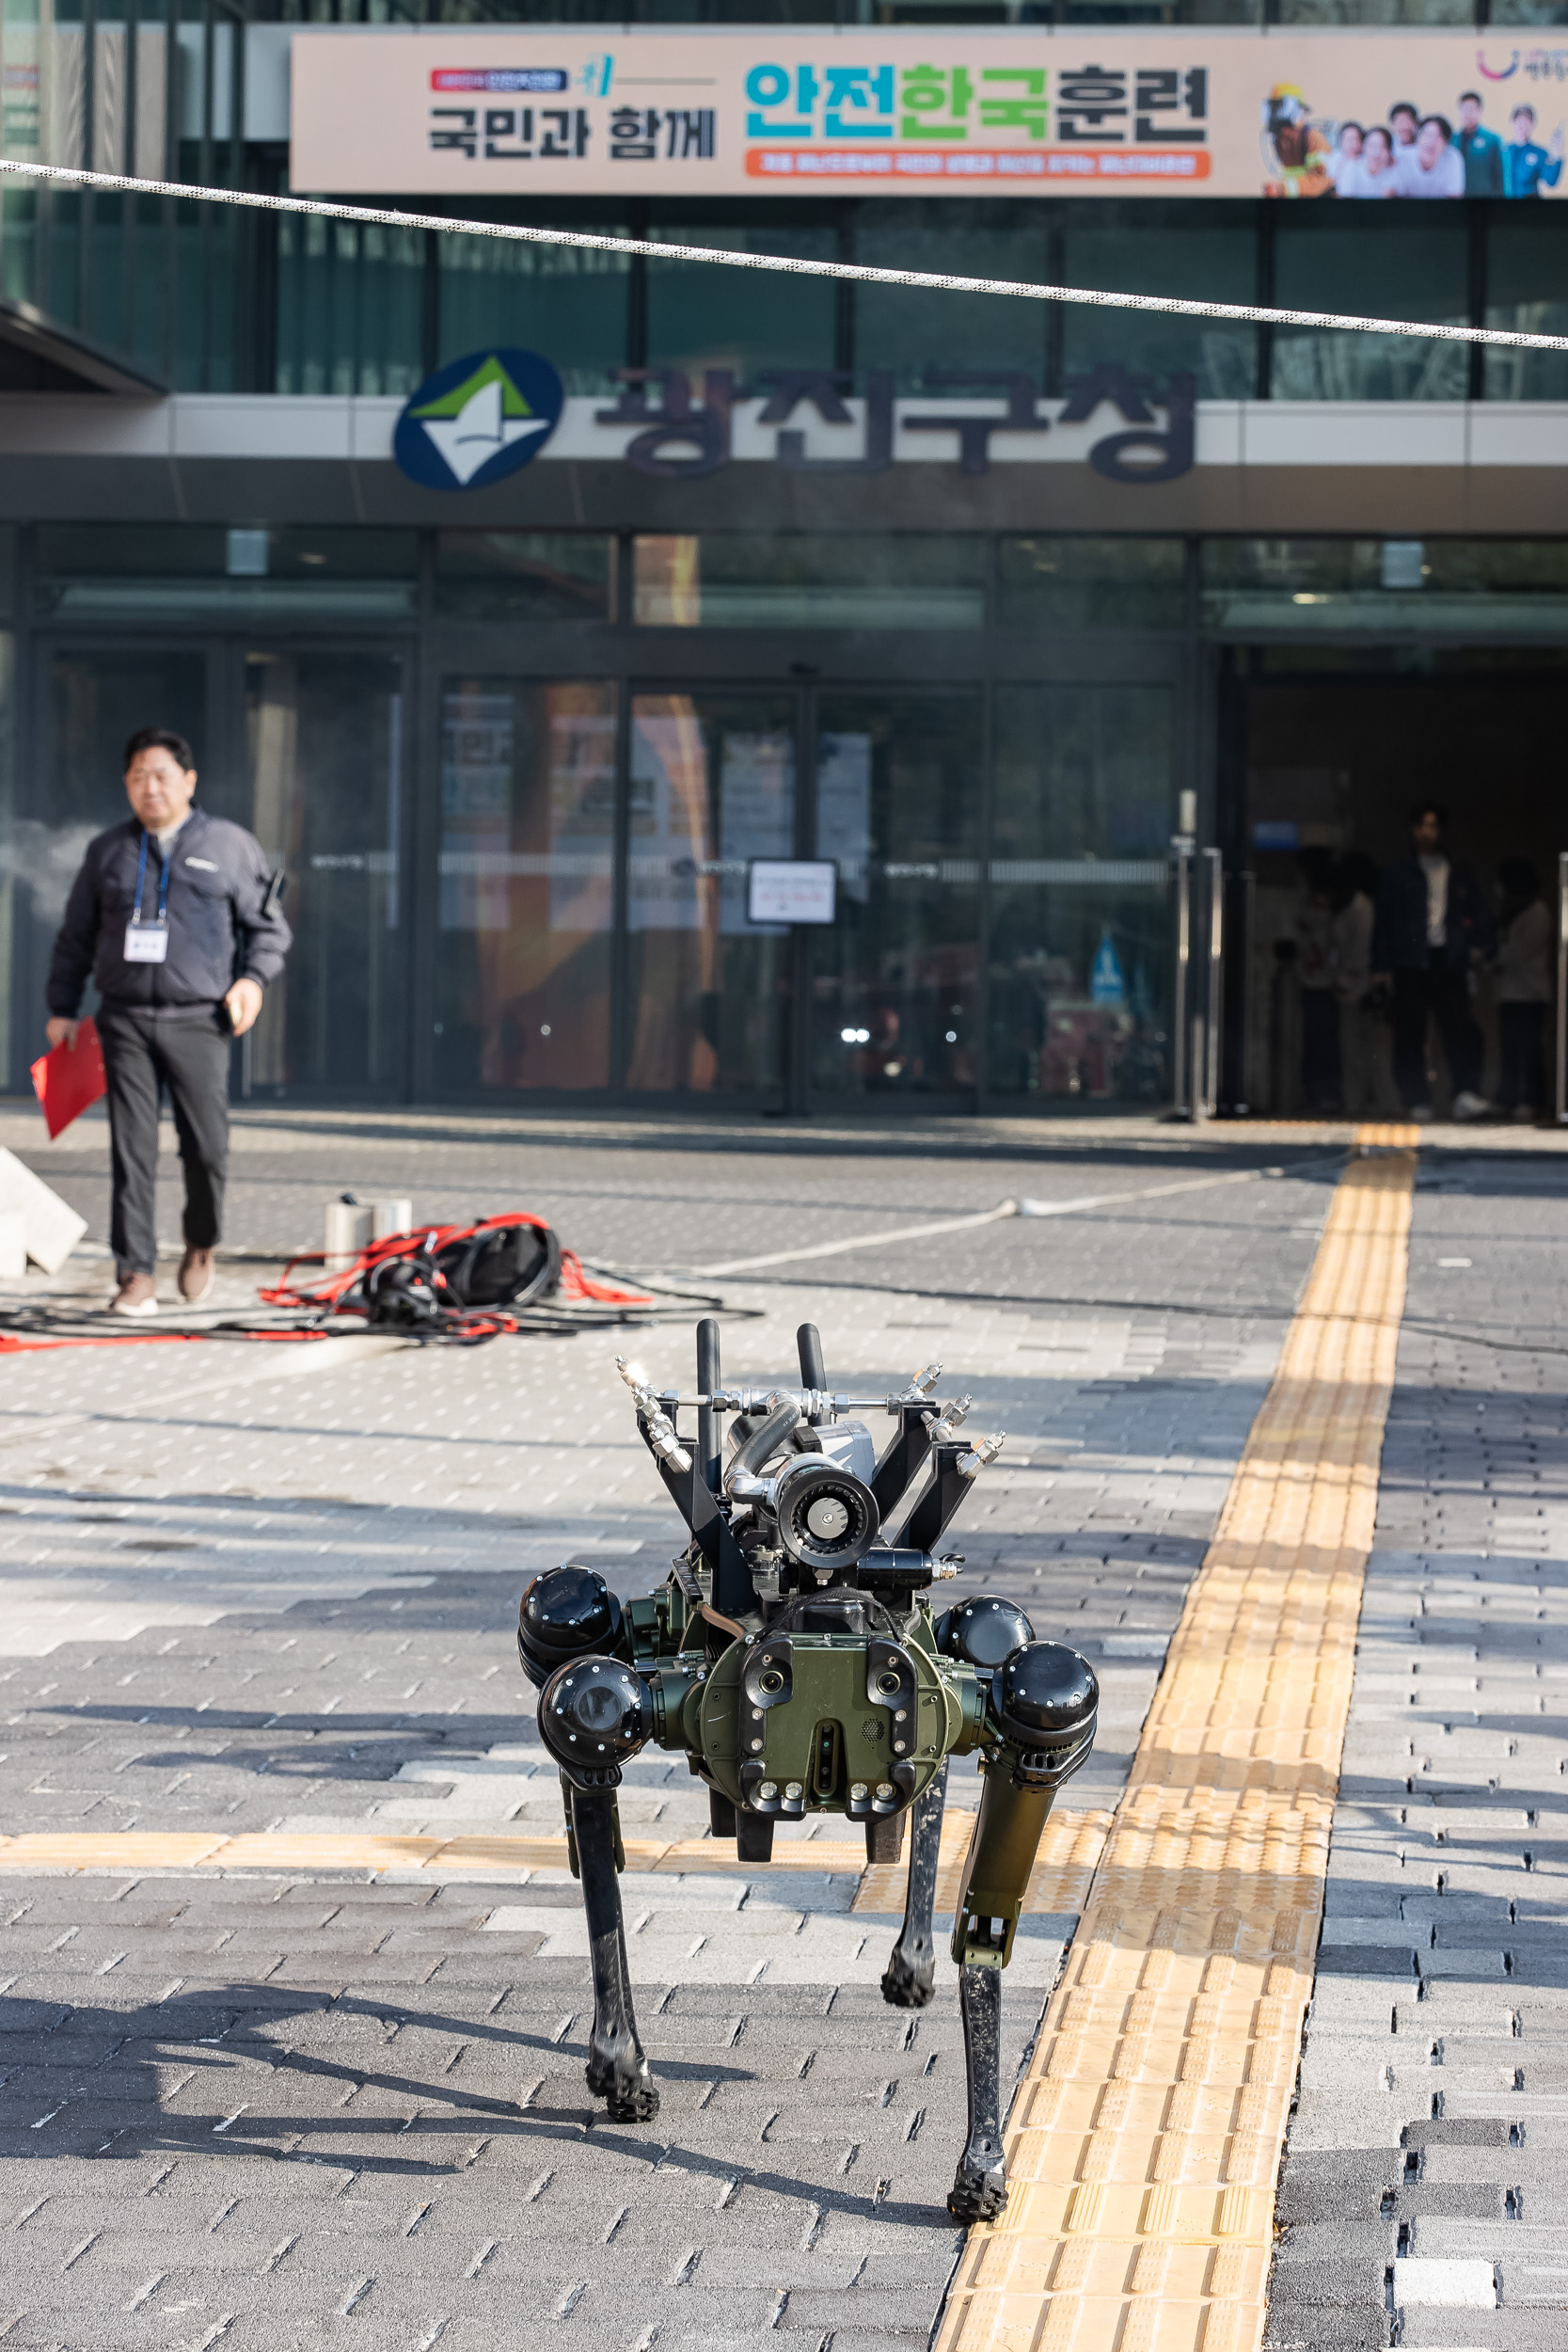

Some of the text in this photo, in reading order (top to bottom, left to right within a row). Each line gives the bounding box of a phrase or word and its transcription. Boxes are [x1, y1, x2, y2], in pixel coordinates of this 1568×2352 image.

[429, 105, 717, 161] 국민과 함께
[745, 63, 1209, 141] 안전한국훈련
[594, 367, 1197, 485] 광진구청
